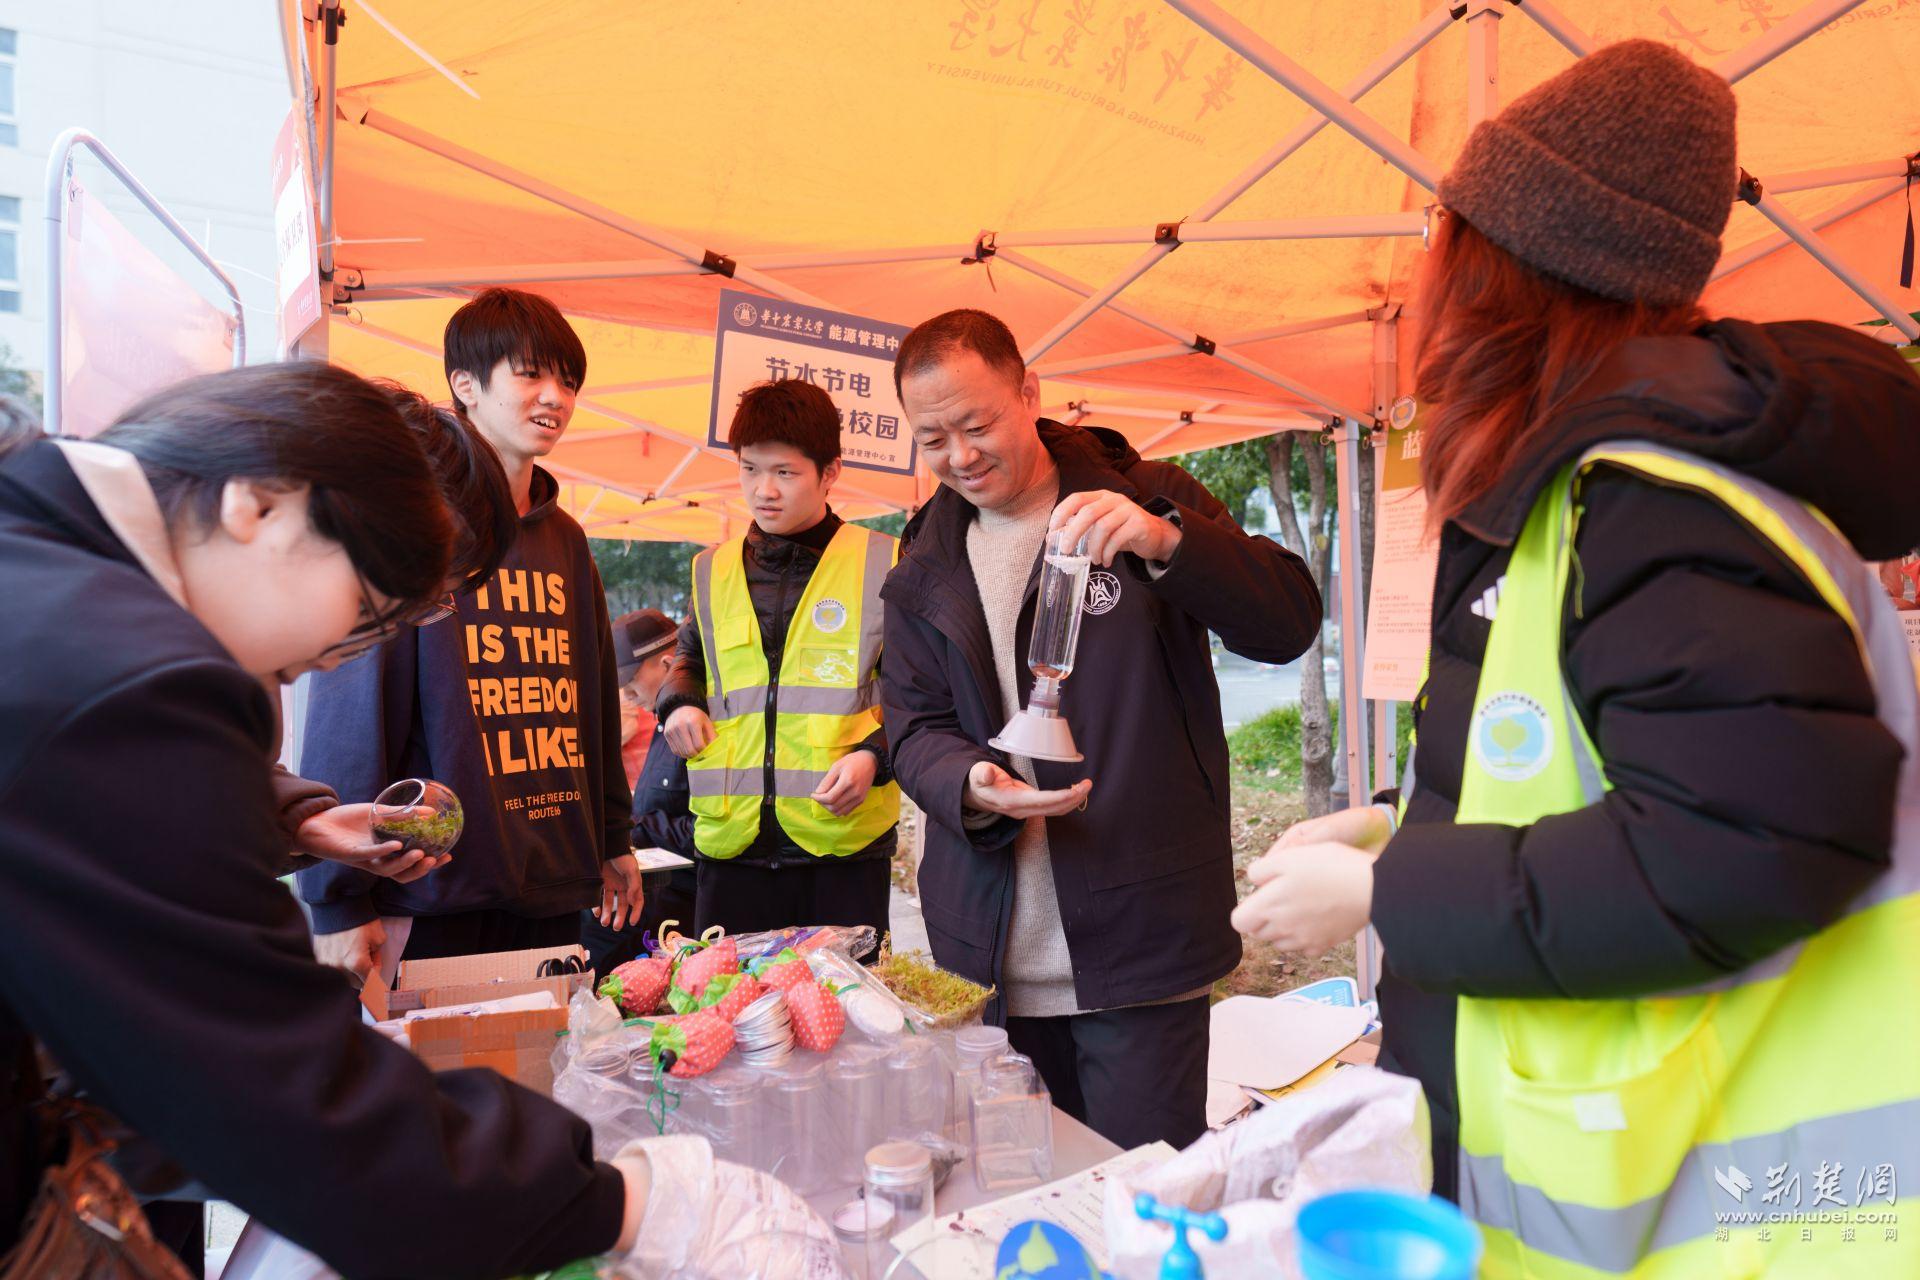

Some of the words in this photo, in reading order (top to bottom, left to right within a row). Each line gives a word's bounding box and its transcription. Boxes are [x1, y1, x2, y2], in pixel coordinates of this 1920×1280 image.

[765, 356, 871, 398] 节水节电
[465, 624, 505, 664] IS
[511, 626, 571, 665] THE
[481, 732, 495, 777] I
[498, 727, 585, 775] LIKE.
[504, 798, 525, 812] FEEL
[526, 794, 546, 807] THE
[546, 791, 582, 803] FREEDO
